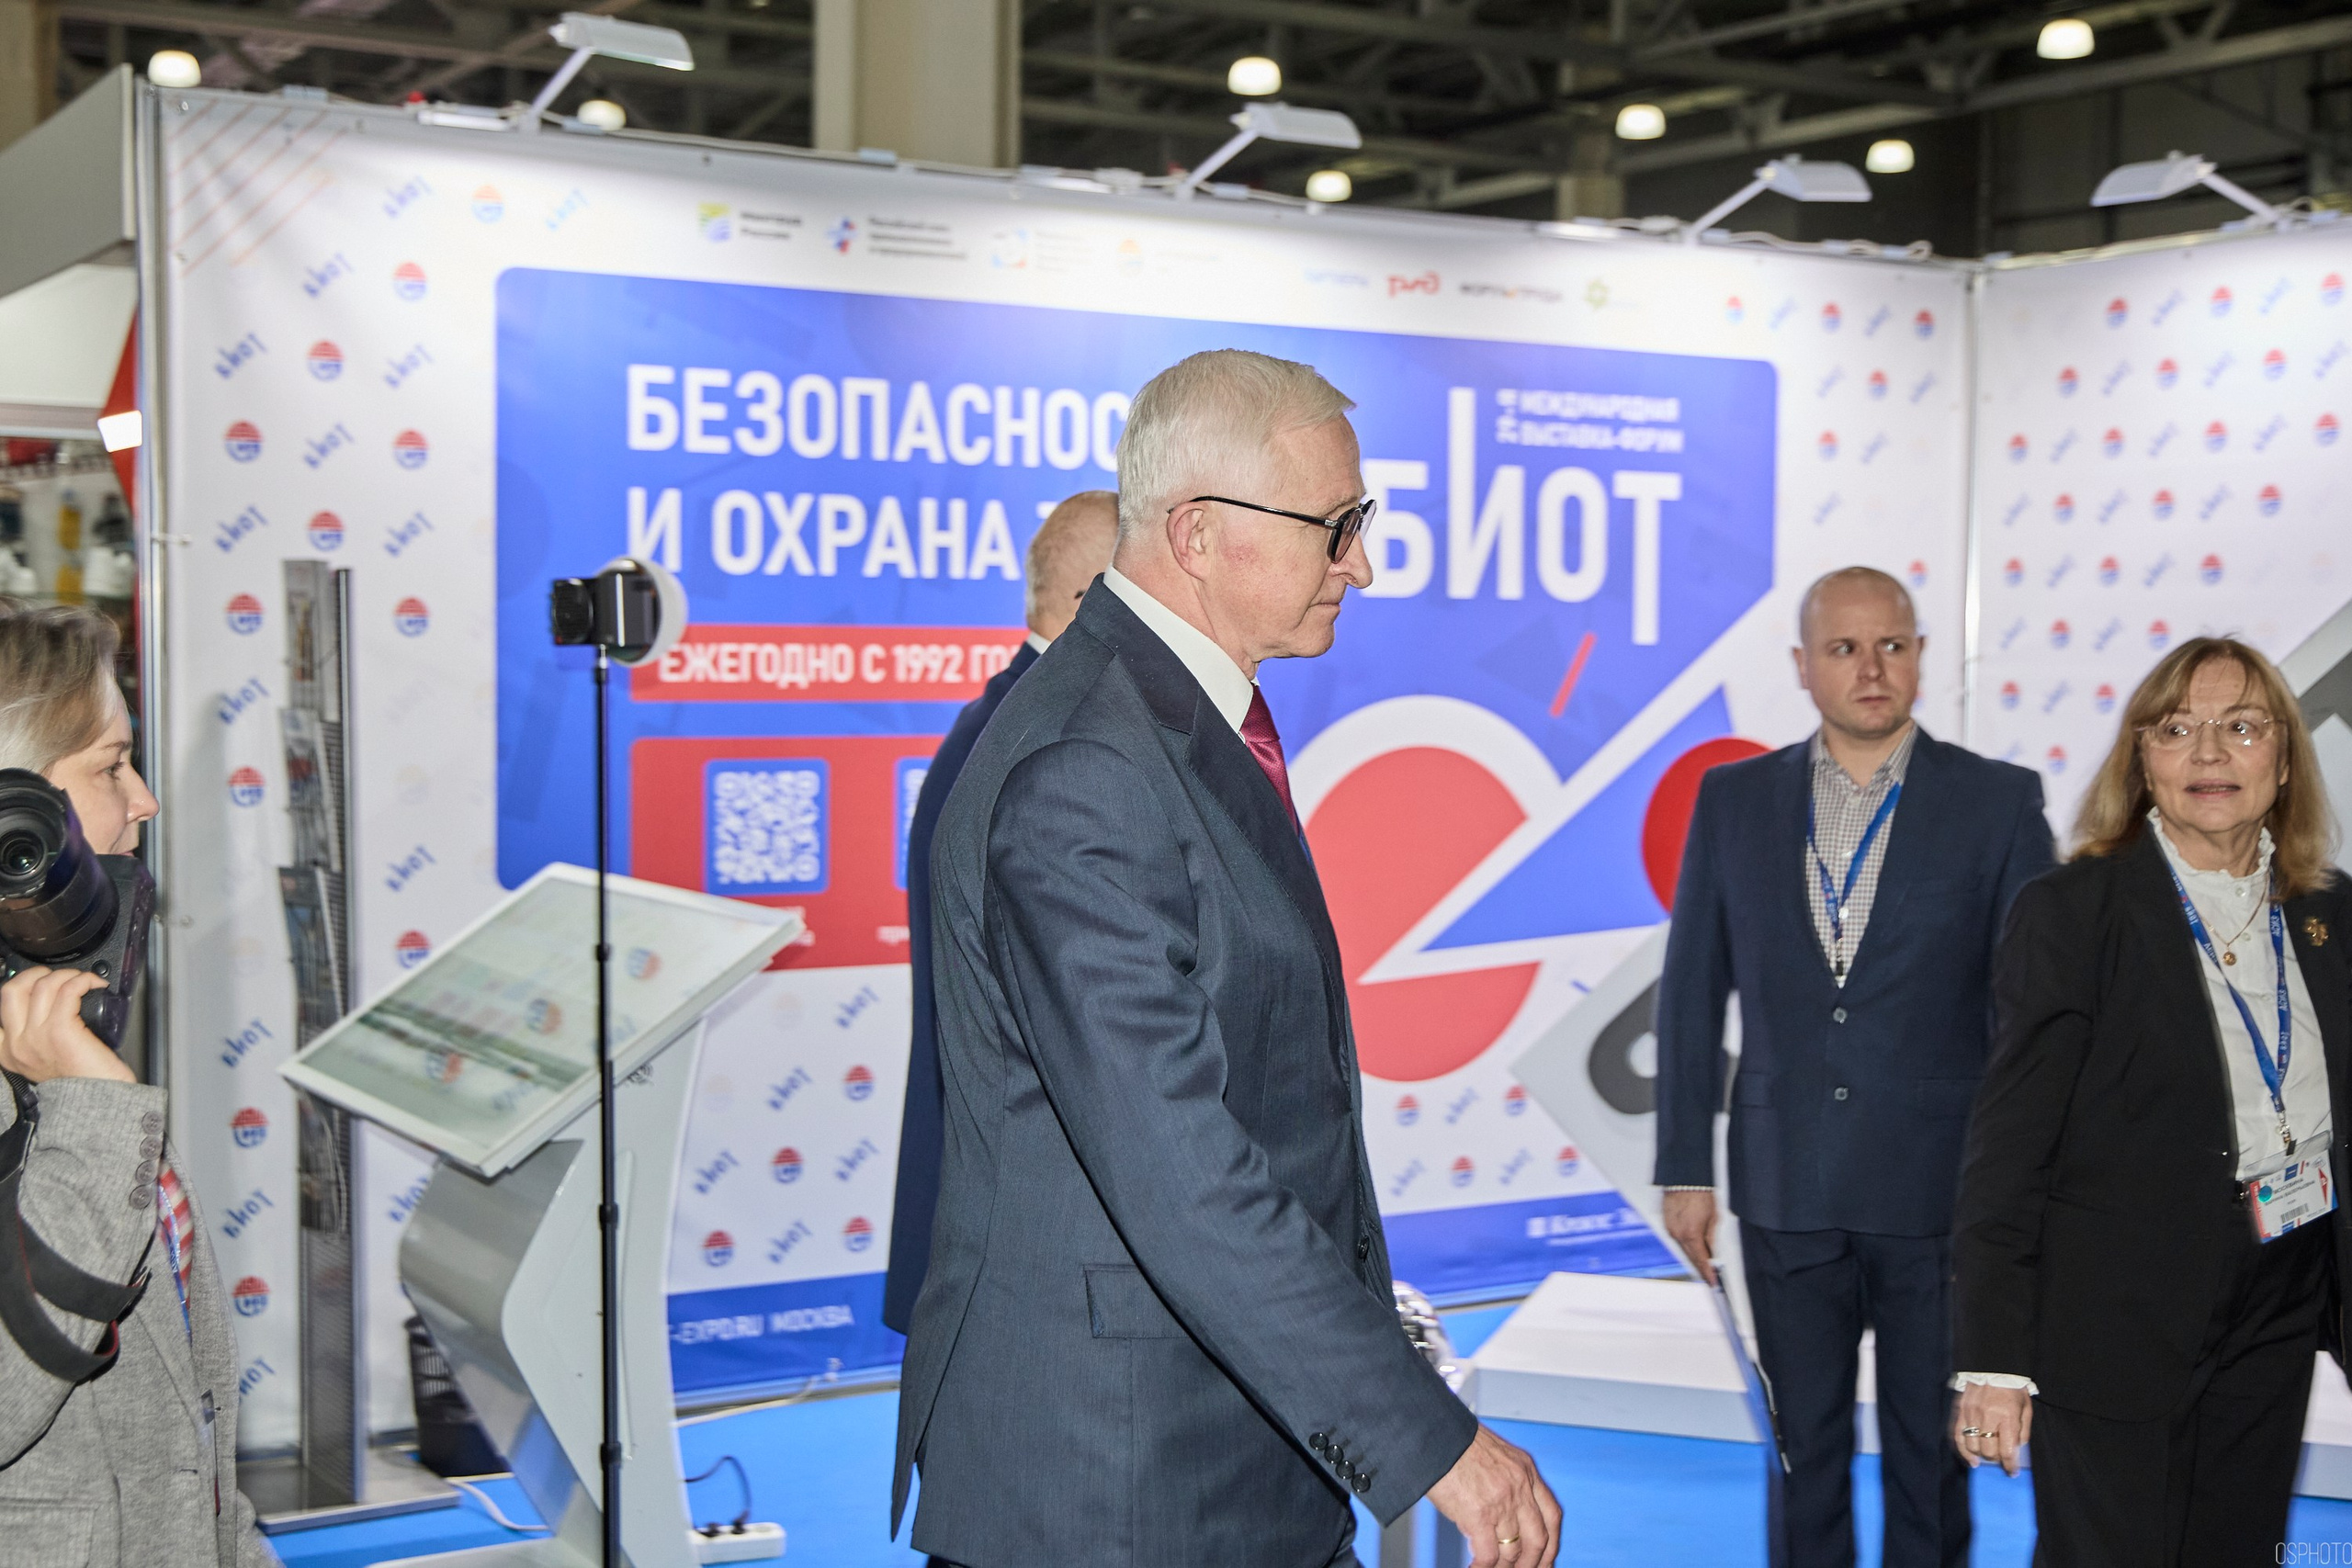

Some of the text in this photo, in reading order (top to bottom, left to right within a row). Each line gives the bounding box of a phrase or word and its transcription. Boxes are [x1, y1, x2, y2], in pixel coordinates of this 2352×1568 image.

[627, 364, 1132, 473] БЕЗОПАСНОС
[627, 486, 1022, 581] И ОХРАНА
[1360, 386, 1682, 646] БИОТ
[658, 641, 1021, 688] ЕЖЕГОДНО С 1992 ГО
